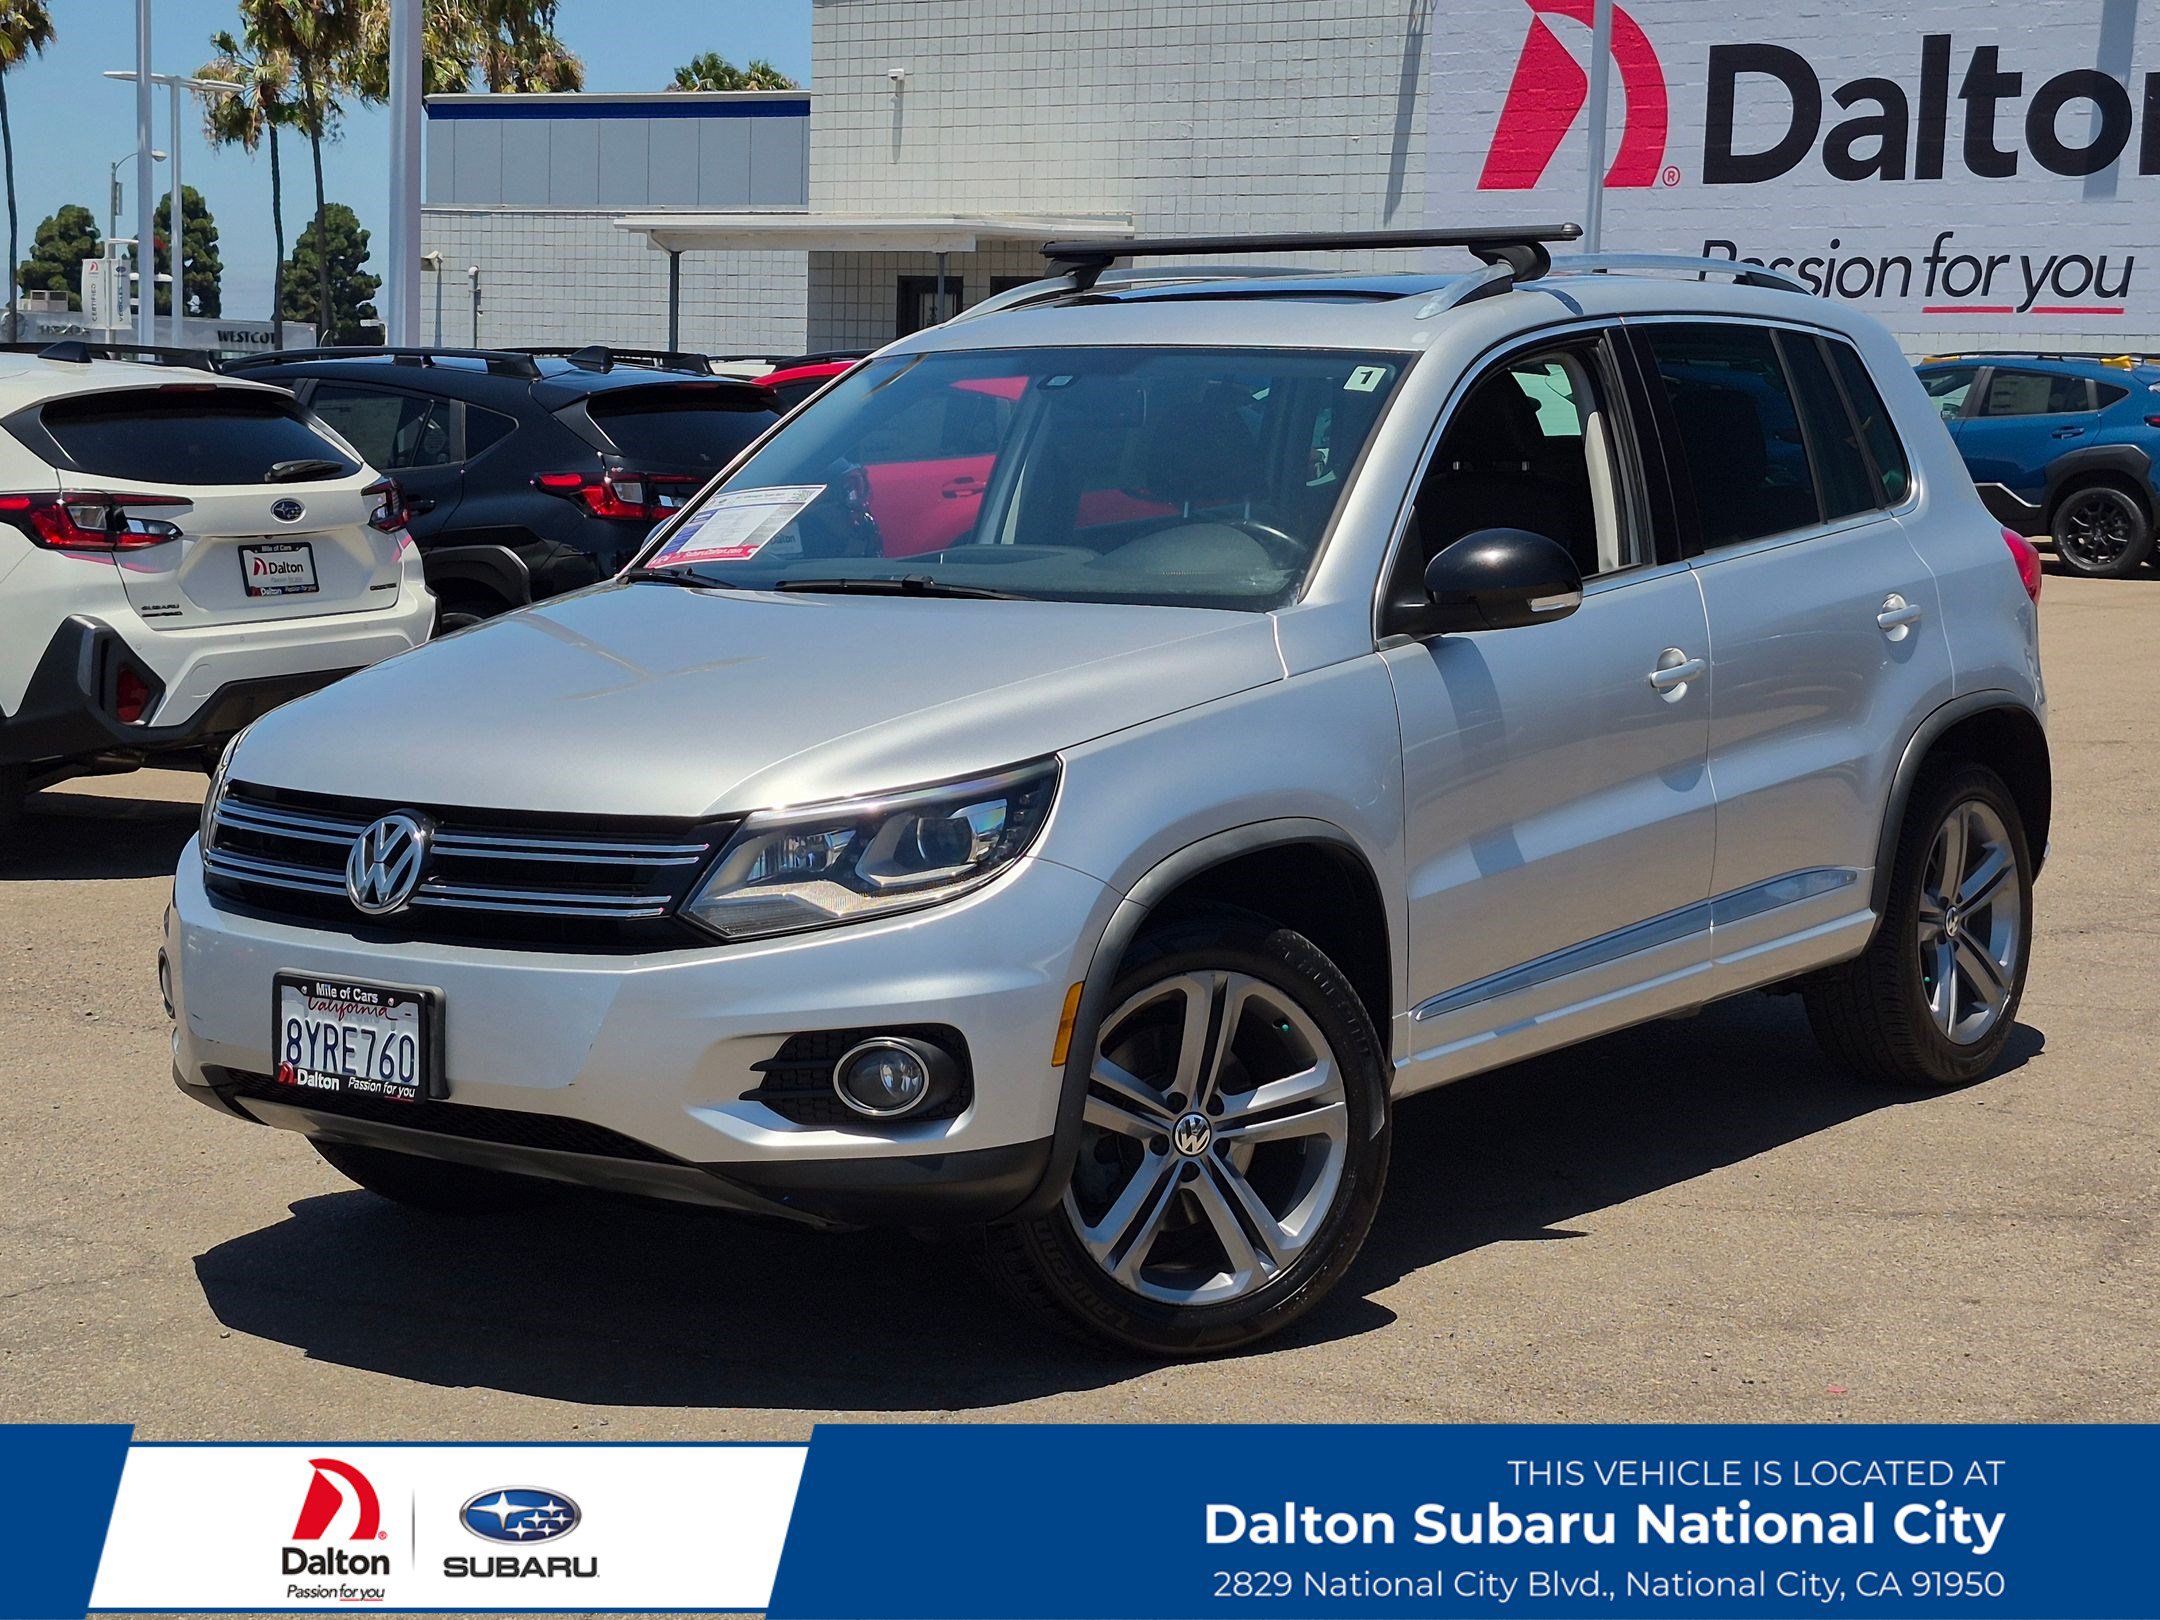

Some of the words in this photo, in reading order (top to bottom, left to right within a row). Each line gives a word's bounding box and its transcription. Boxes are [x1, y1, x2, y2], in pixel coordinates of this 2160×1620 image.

[1702, 238, 1912, 299] Psion
[1923, 231, 2010, 298] for
[2016, 254, 2135, 313] you
[1359, 370, 1374, 385] 1
[269, 562, 304, 575] Dalton
[315, 982, 338, 999] Mile
[339, 987, 351, 1000] of
[353, 988, 379, 1004] Cars
[307, 996, 398, 1021] California
[286, 1017, 416, 1083] 8YRE760
[296, 1068, 340, 1091] Dalton
[348, 1076, 382, 1092] Passion
[383, 1081, 397, 1095] for
[397, 1085, 416, 1099] you
